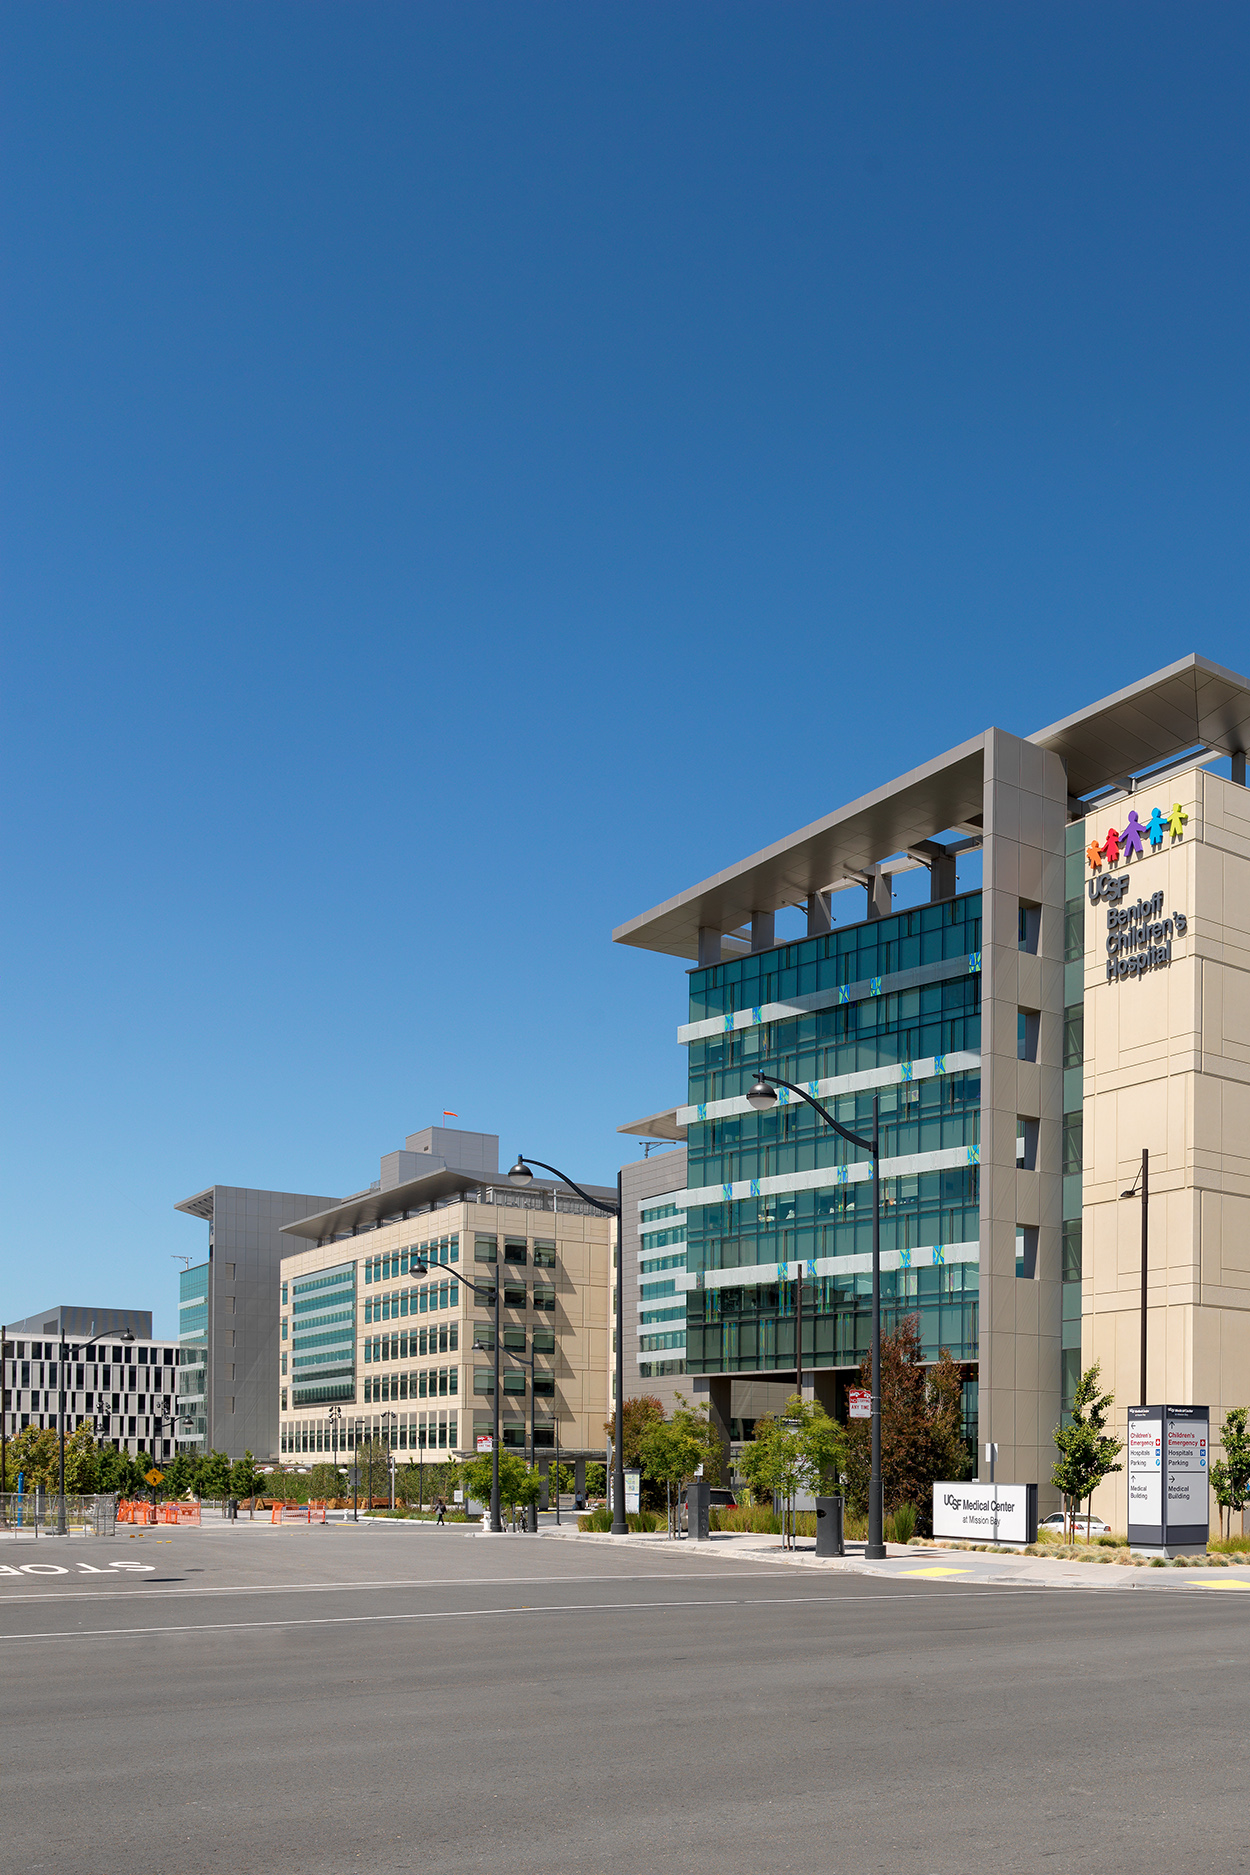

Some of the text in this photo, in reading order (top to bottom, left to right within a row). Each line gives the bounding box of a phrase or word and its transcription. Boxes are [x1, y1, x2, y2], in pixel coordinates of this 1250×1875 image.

[1089, 873, 1130, 901] UCSF
[1107, 890, 1165, 929] Benioff
[1106, 911, 1187, 954] Children's
[1106, 940, 1172, 978] Hospital
[1168, 1439, 1198, 1447] Emergency
[943, 1494, 1015, 1512] UCSF Medical Center
[969, 1515, 989, 1525] Mission
[990, 1516, 1001, 1527] Bay
